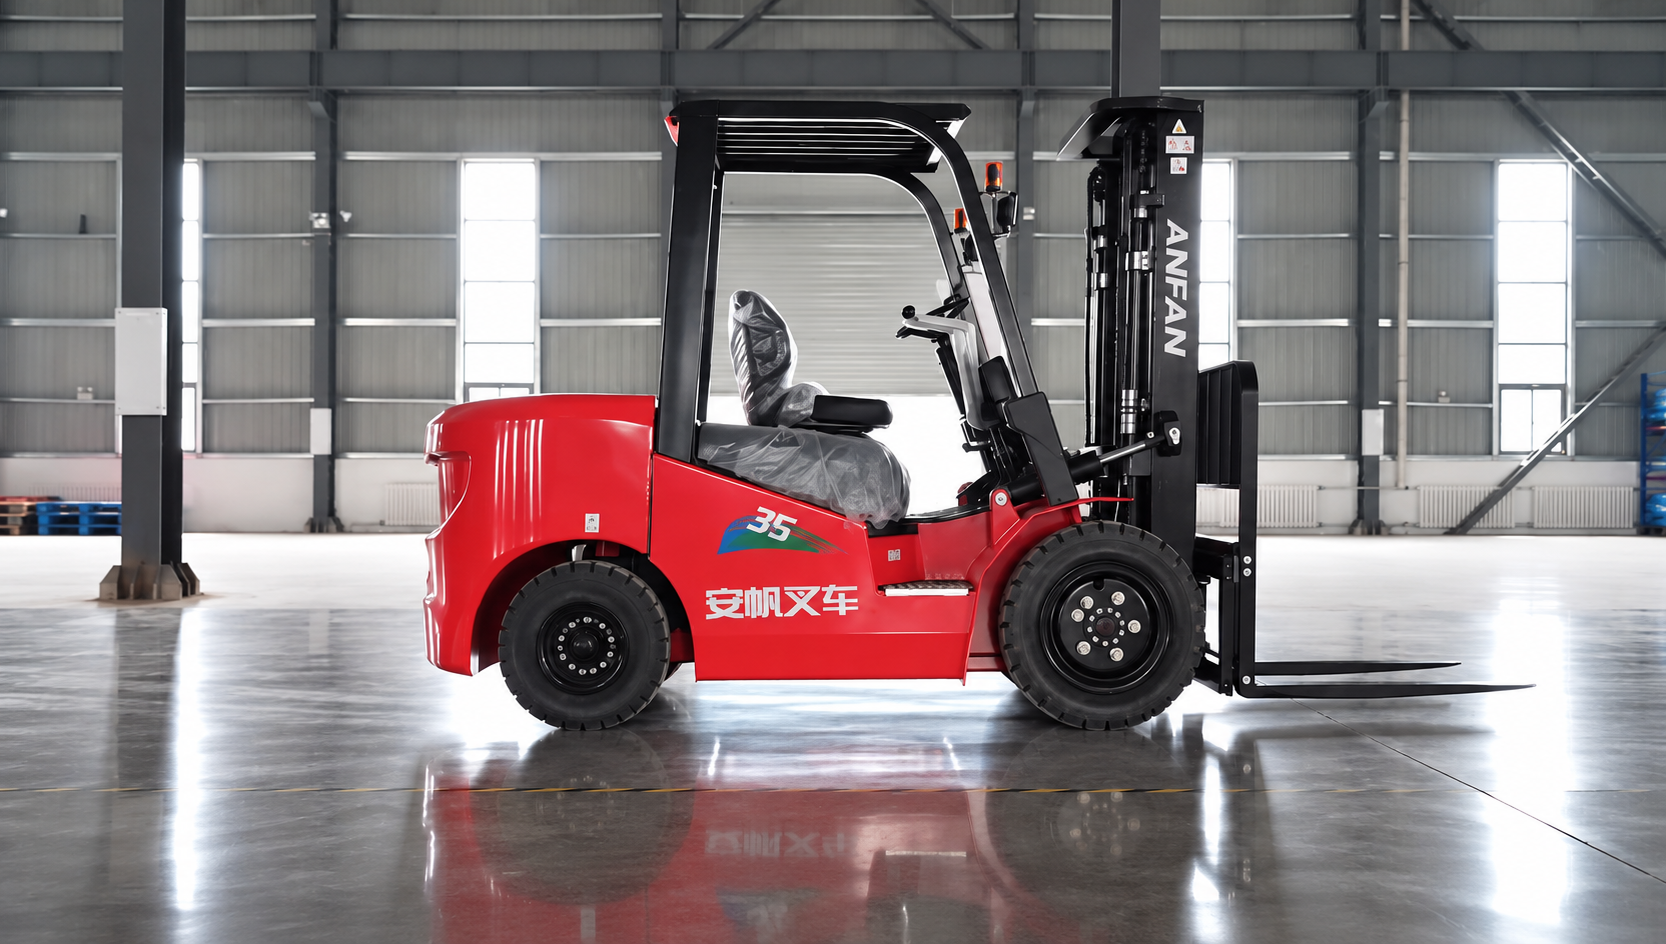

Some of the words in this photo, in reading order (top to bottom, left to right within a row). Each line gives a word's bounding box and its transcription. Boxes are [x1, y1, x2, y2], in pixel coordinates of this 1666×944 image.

[1164, 218, 1189, 358] ANFAN
[746, 506, 798, 542] 35
[705, 585, 859, 620] 安帆叉车
